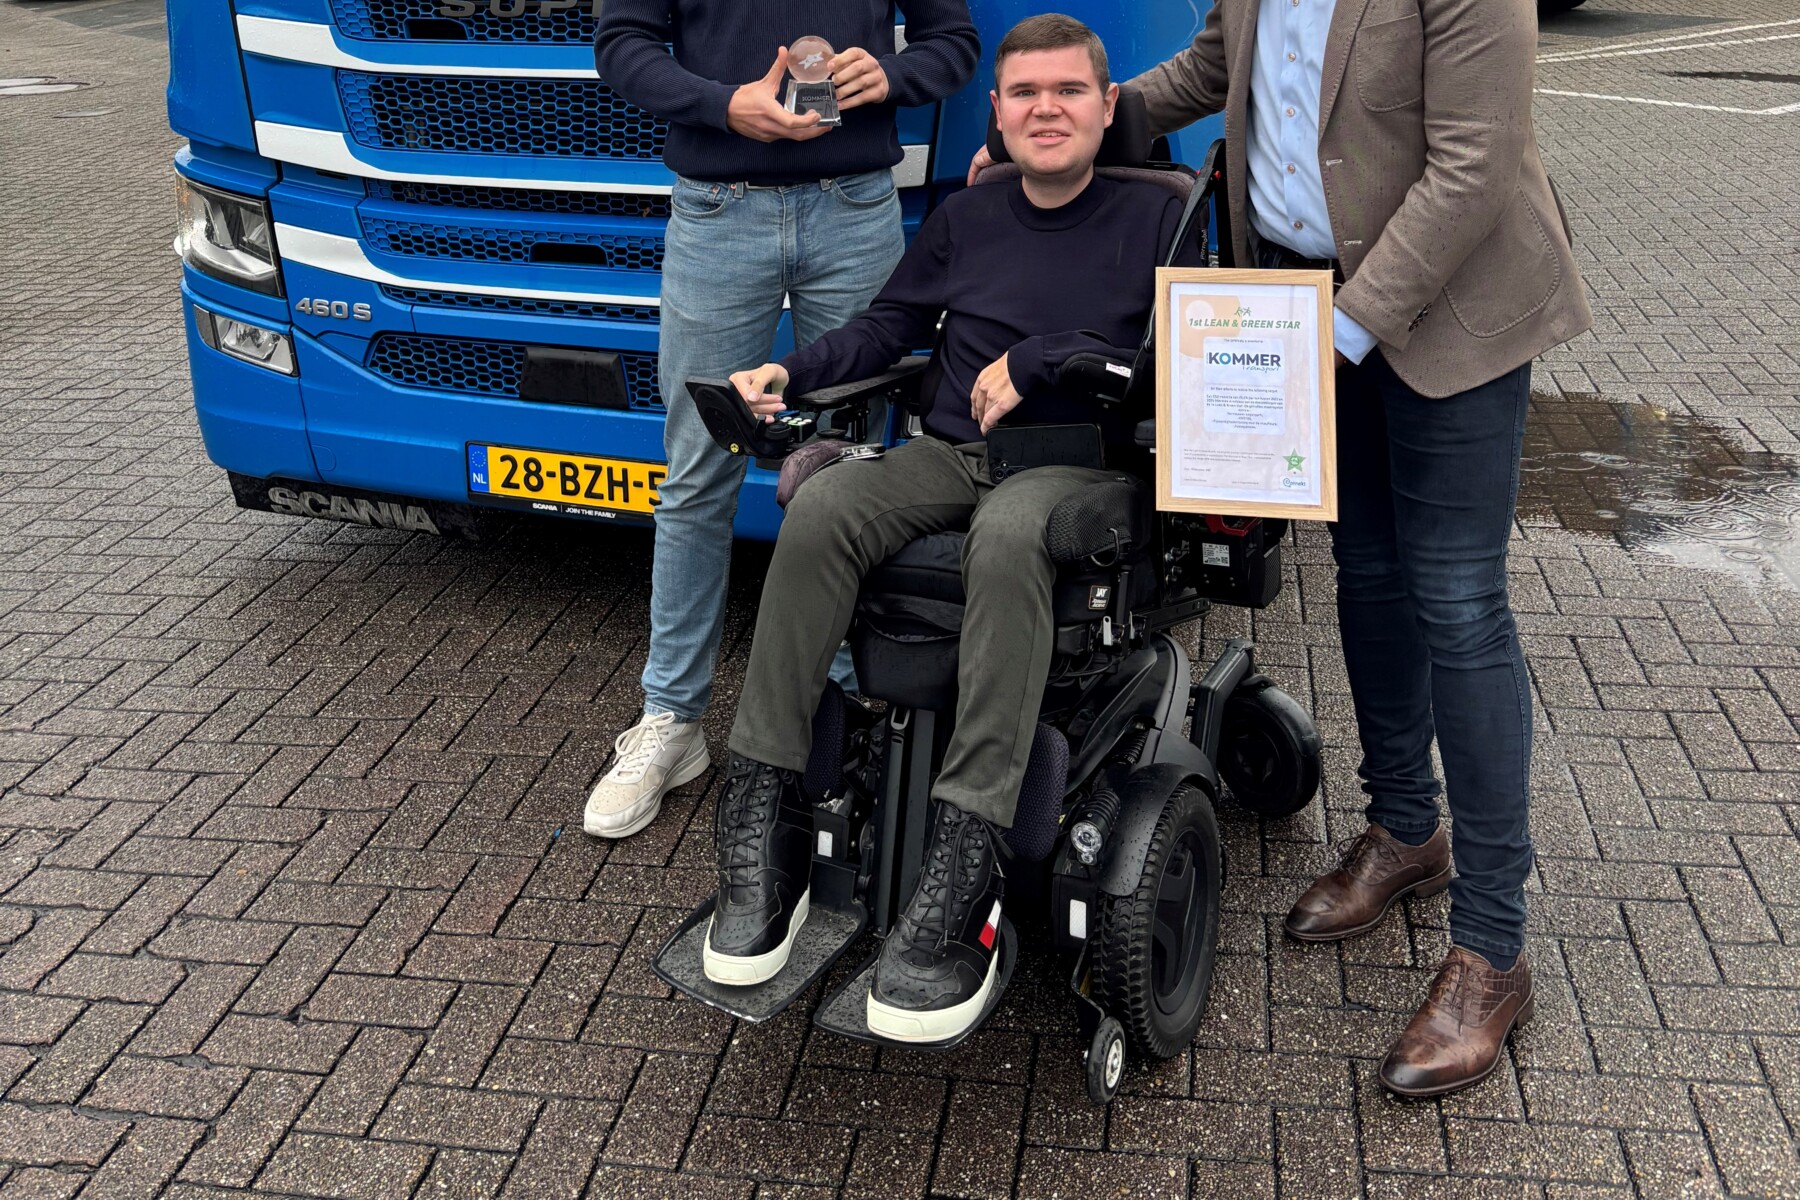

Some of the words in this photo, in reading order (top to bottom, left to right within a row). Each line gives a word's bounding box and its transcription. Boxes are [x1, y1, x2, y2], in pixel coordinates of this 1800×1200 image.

[295, 297, 349, 319] 460
[353, 302, 371, 320] S
[1188, 319, 1202, 327] 1st
[1204, 319, 1230, 327] LEAN
[1231, 319, 1239, 328] &
[1241, 319, 1274, 329] GREEN
[1275, 320, 1301, 330] STAR
[1208, 352, 1282, 368] KOMMER
[472, 472, 487, 485] NL
[500, 454, 666, 506] 28-BZH-5
[268, 486, 441, 535] SCANIA
[532, 502, 558, 512] SCANIA
[565, 506, 581, 514] JOIN
[581, 508, 593, 516] THE
[594, 510, 617, 519] FAMILY
